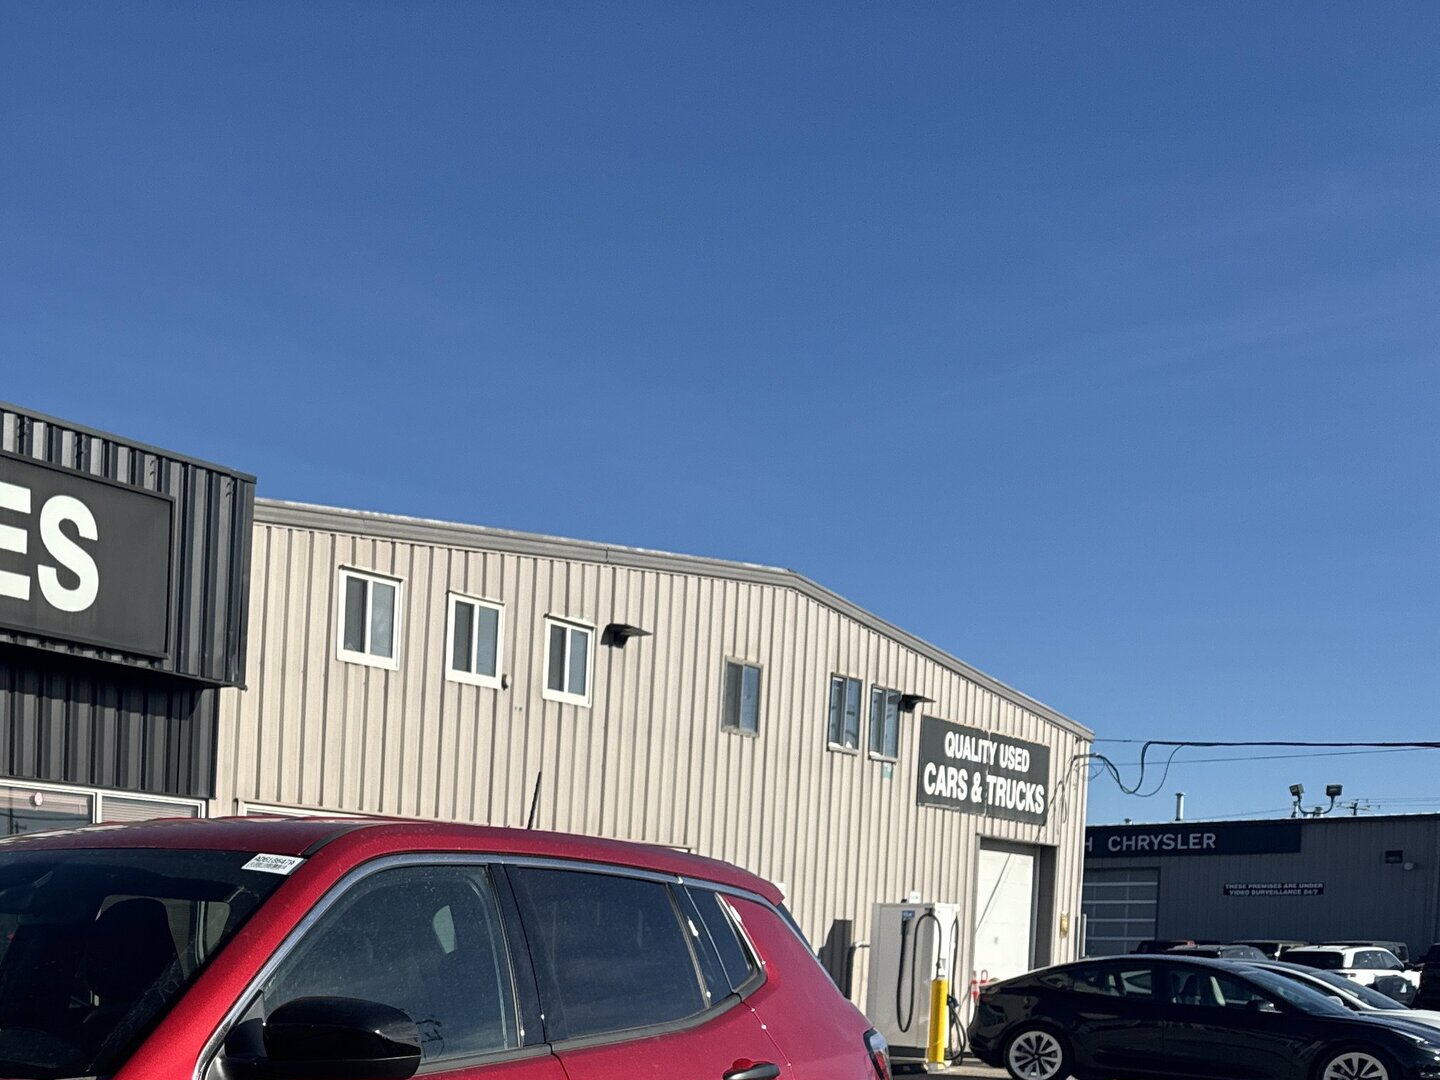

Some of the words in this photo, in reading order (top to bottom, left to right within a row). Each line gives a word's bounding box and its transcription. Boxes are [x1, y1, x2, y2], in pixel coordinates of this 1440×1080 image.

[944, 731, 998, 766] QUALITY
[999, 744, 1031, 773] USED
[923, 762, 969, 801] CARS
[971, 771, 983, 803] &
[986, 774, 1045, 815] TRUCKS
[1108, 833, 1217, 852] CHRYSLER
